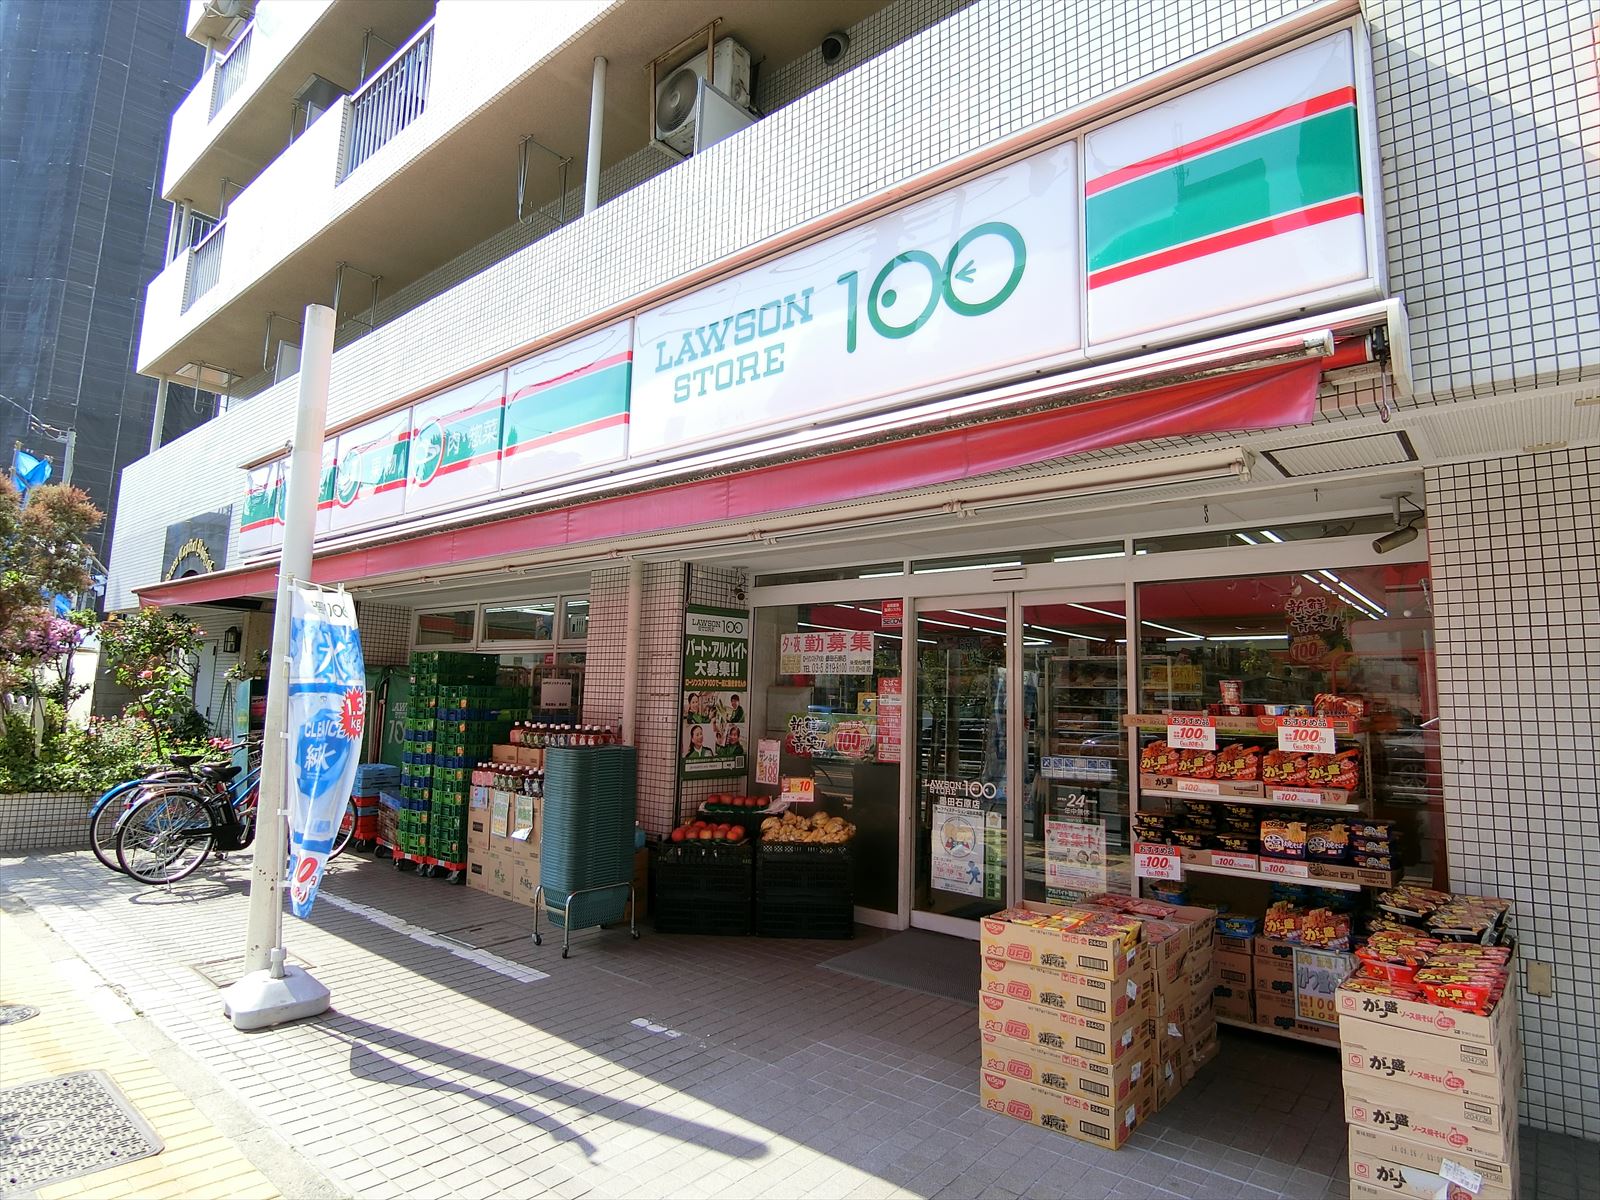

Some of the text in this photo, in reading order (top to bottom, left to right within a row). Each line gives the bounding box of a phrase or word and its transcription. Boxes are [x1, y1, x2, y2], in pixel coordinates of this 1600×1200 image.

[837, 221, 1027, 354] 100
[655, 286, 815, 374] LAWSON
[673, 342, 785, 404] STORE
[692, 618, 721, 628] LAWSON
[722, 620, 744, 634] 100
[686, 638, 748, 660] パート・アルバイト
[694, 660, 740, 677] 大募集!!
[346, 698, 364, 716] 1.3
[351, 718, 362, 731] kg
[1172, 717, 1210, 726] おすすめ品
[1283, 718, 1327, 727] おすすめ品
[924, 779, 962, 790] LAWSON
[929, 786, 957, 796] STORE
[963, 780, 997, 799] 100
[1066, 793, 1086, 808] 24
[1139, 846, 1175, 855] おすすめ品
[1363, 998, 1398, 1018] がっ盛
[1369, 1056, 1405, 1076] がっ盛
[1372, 1109, 1446, 1139] がっ盛 ソース焼そば
